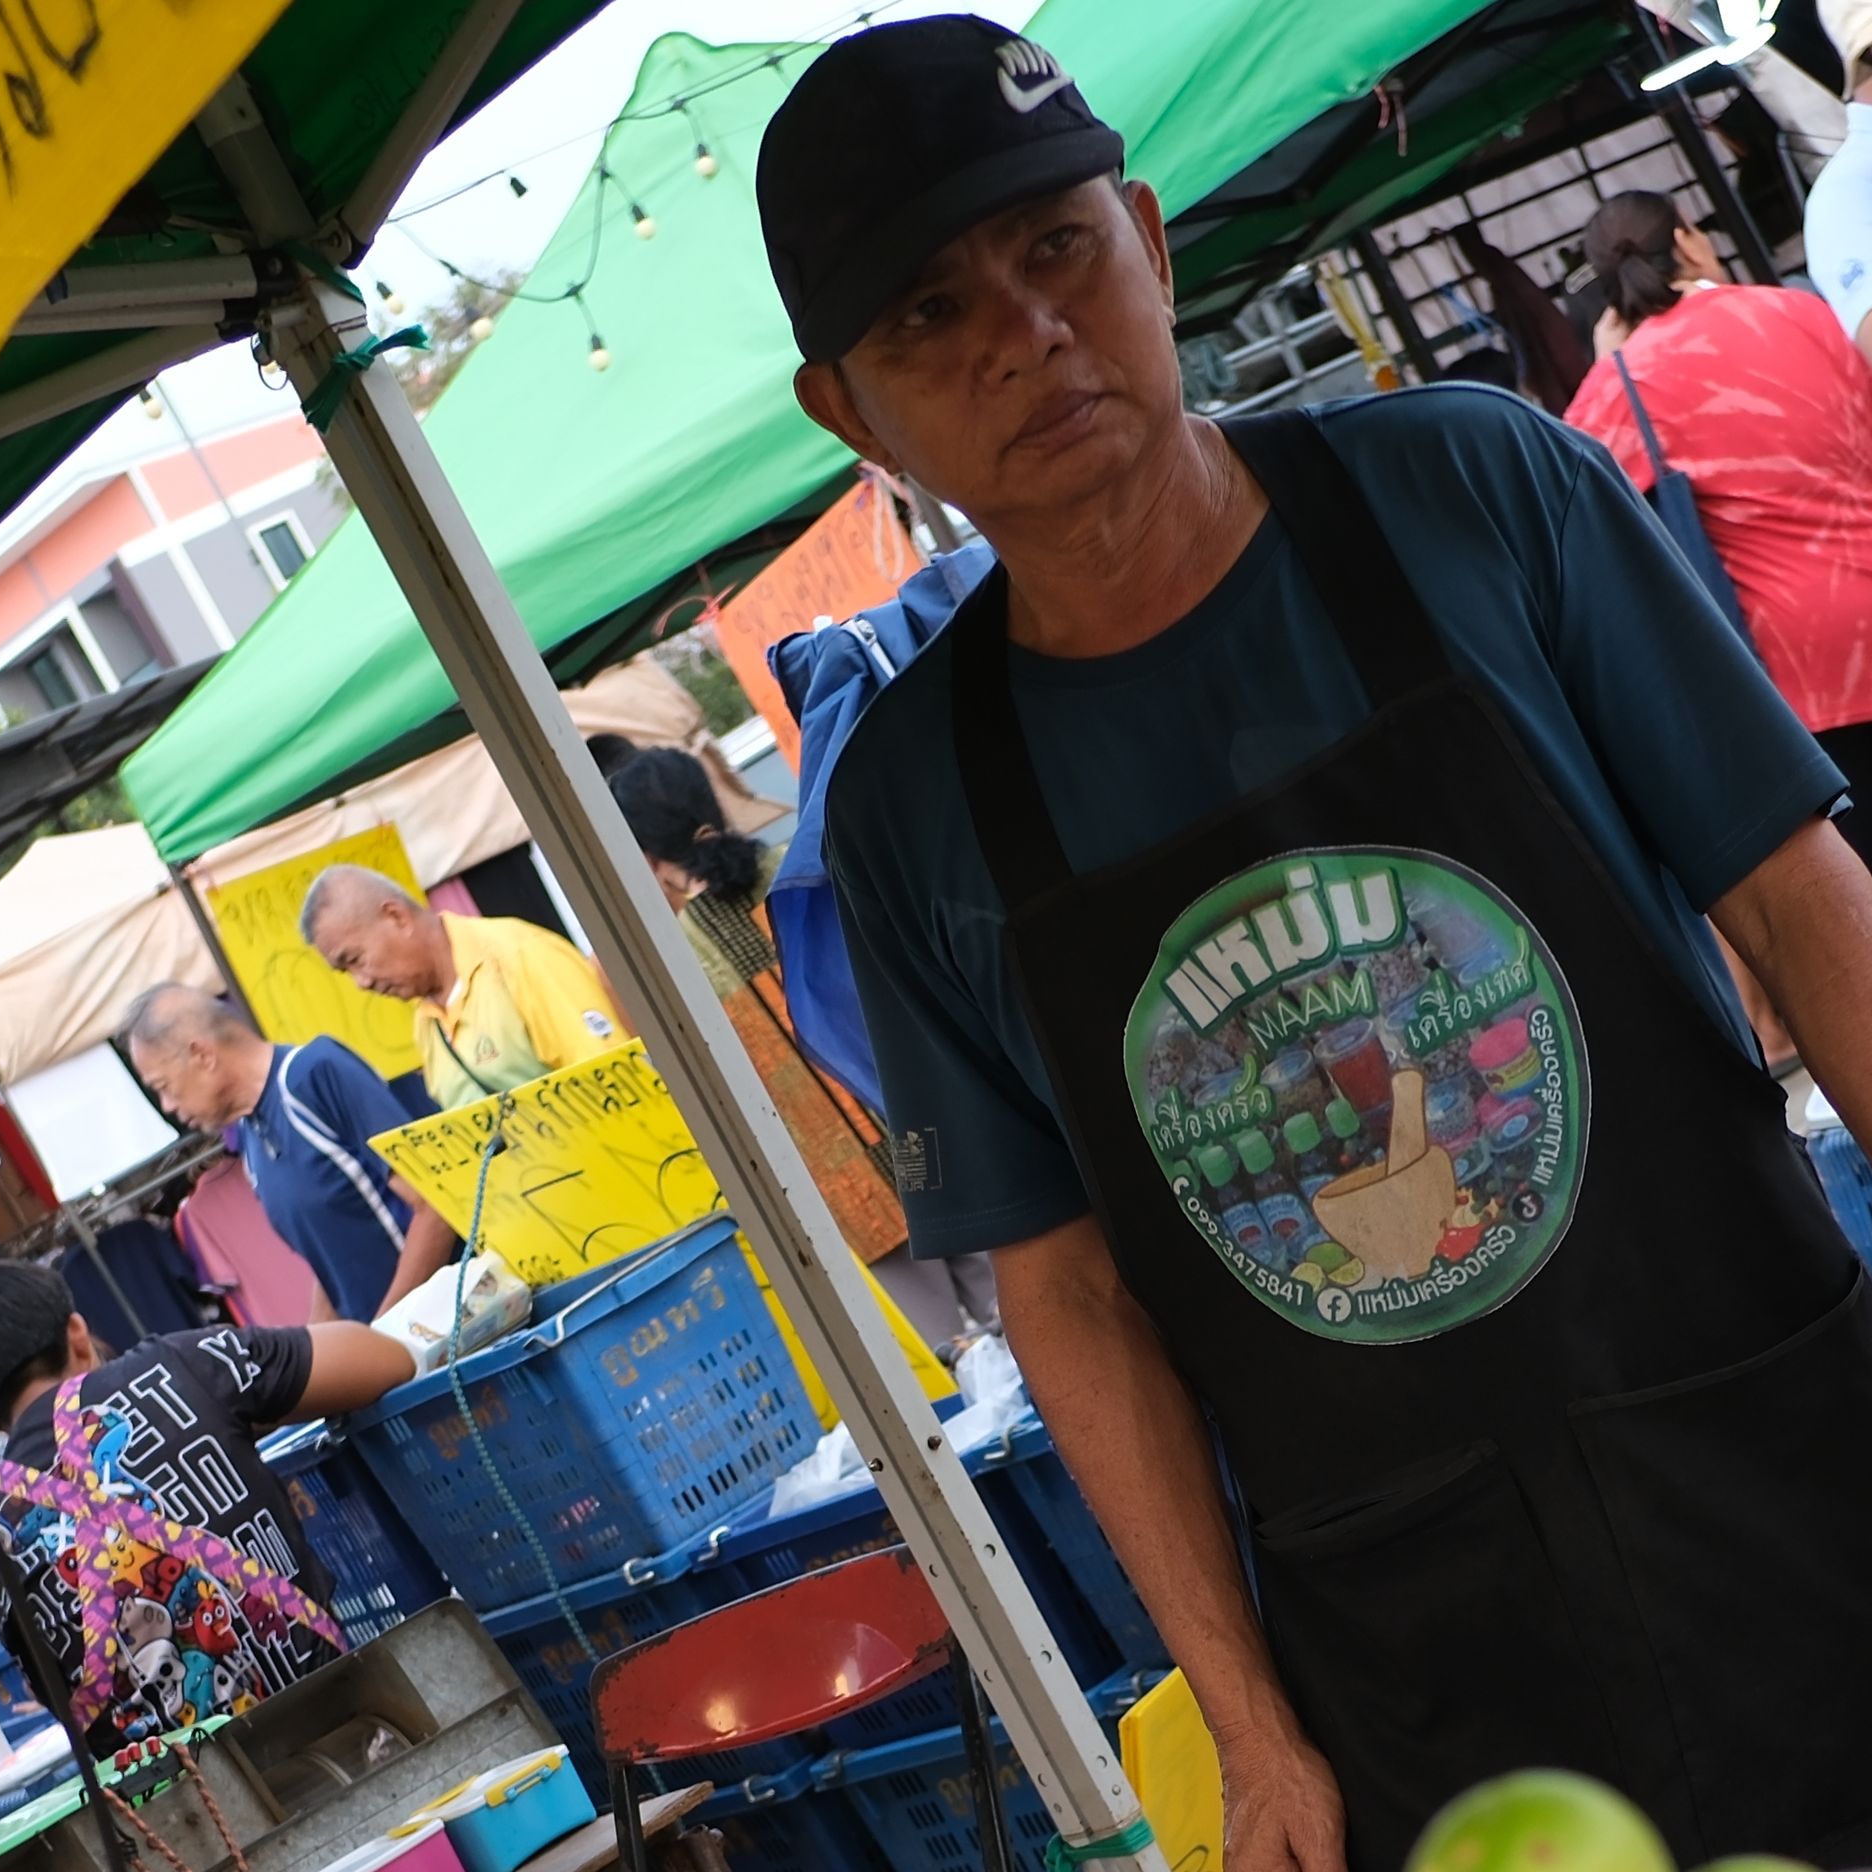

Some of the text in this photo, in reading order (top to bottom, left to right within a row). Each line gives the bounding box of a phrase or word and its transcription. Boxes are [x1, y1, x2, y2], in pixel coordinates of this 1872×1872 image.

[1165, 865, 1401, 1028] แหม่ม
[1407, 926, 1530, 1050] เครื่องเทศ
[1249, 972, 1374, 1050] MAAM
[1153, 1058, 1270, 1152] เครื่องครัว
[1529, 1010, 1564, 1187] แหม่มเครื่องครัว
[1184, 1194, 1306, 1307] 099-3475841
[1358, 1224, 1517, 1317] แหม่มเครื่องครัว
